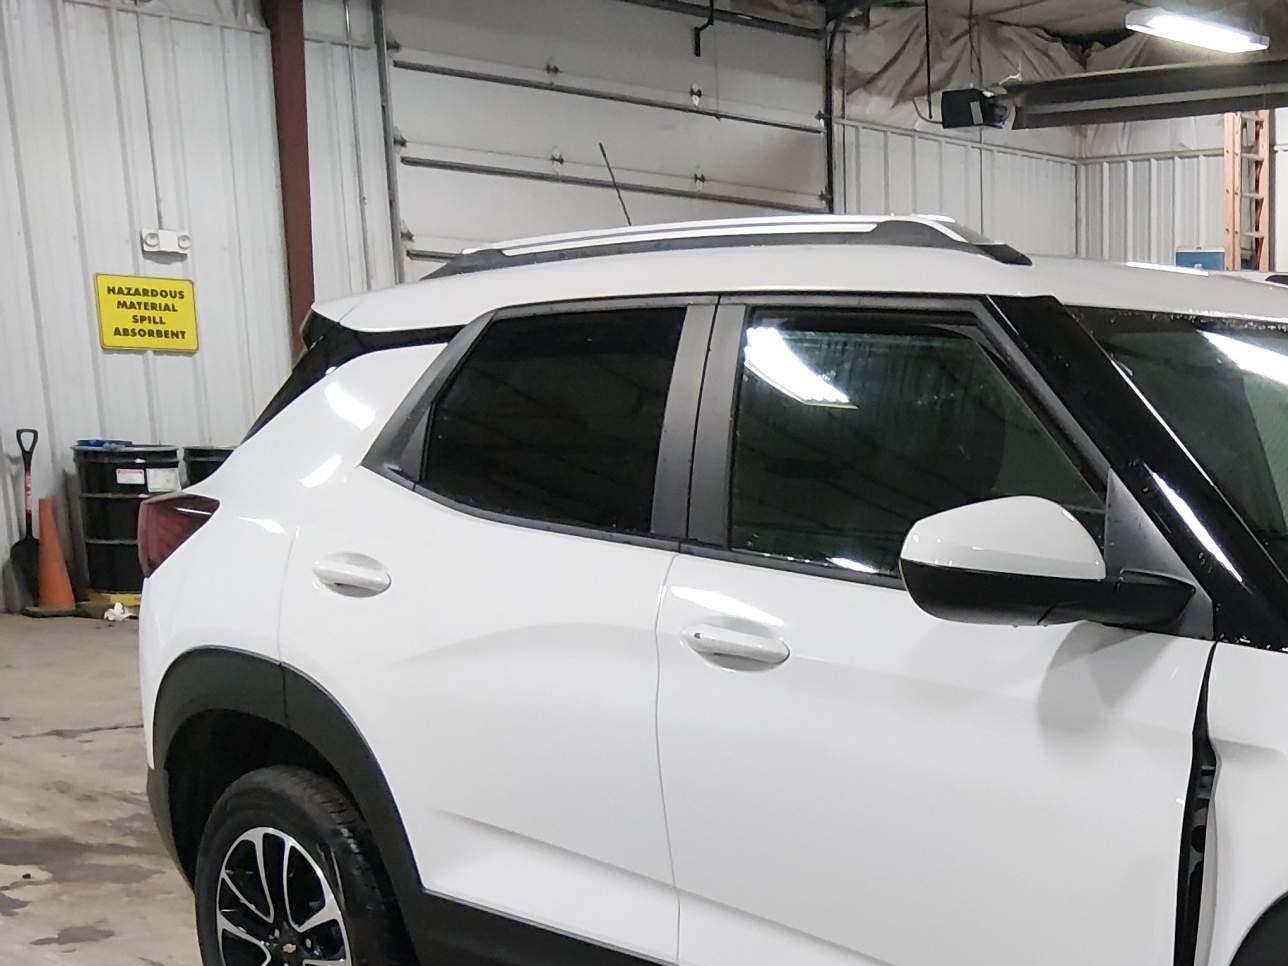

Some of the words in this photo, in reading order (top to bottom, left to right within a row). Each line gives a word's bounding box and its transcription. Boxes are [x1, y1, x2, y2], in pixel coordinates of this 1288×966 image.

[106, 285, 185, 299] HAZARDOUS
[116, 300, 179, 312] MATERIAL
[131, 315, 166, 325] SPILL
[113, 327, 186, 340] ABSORBENT
